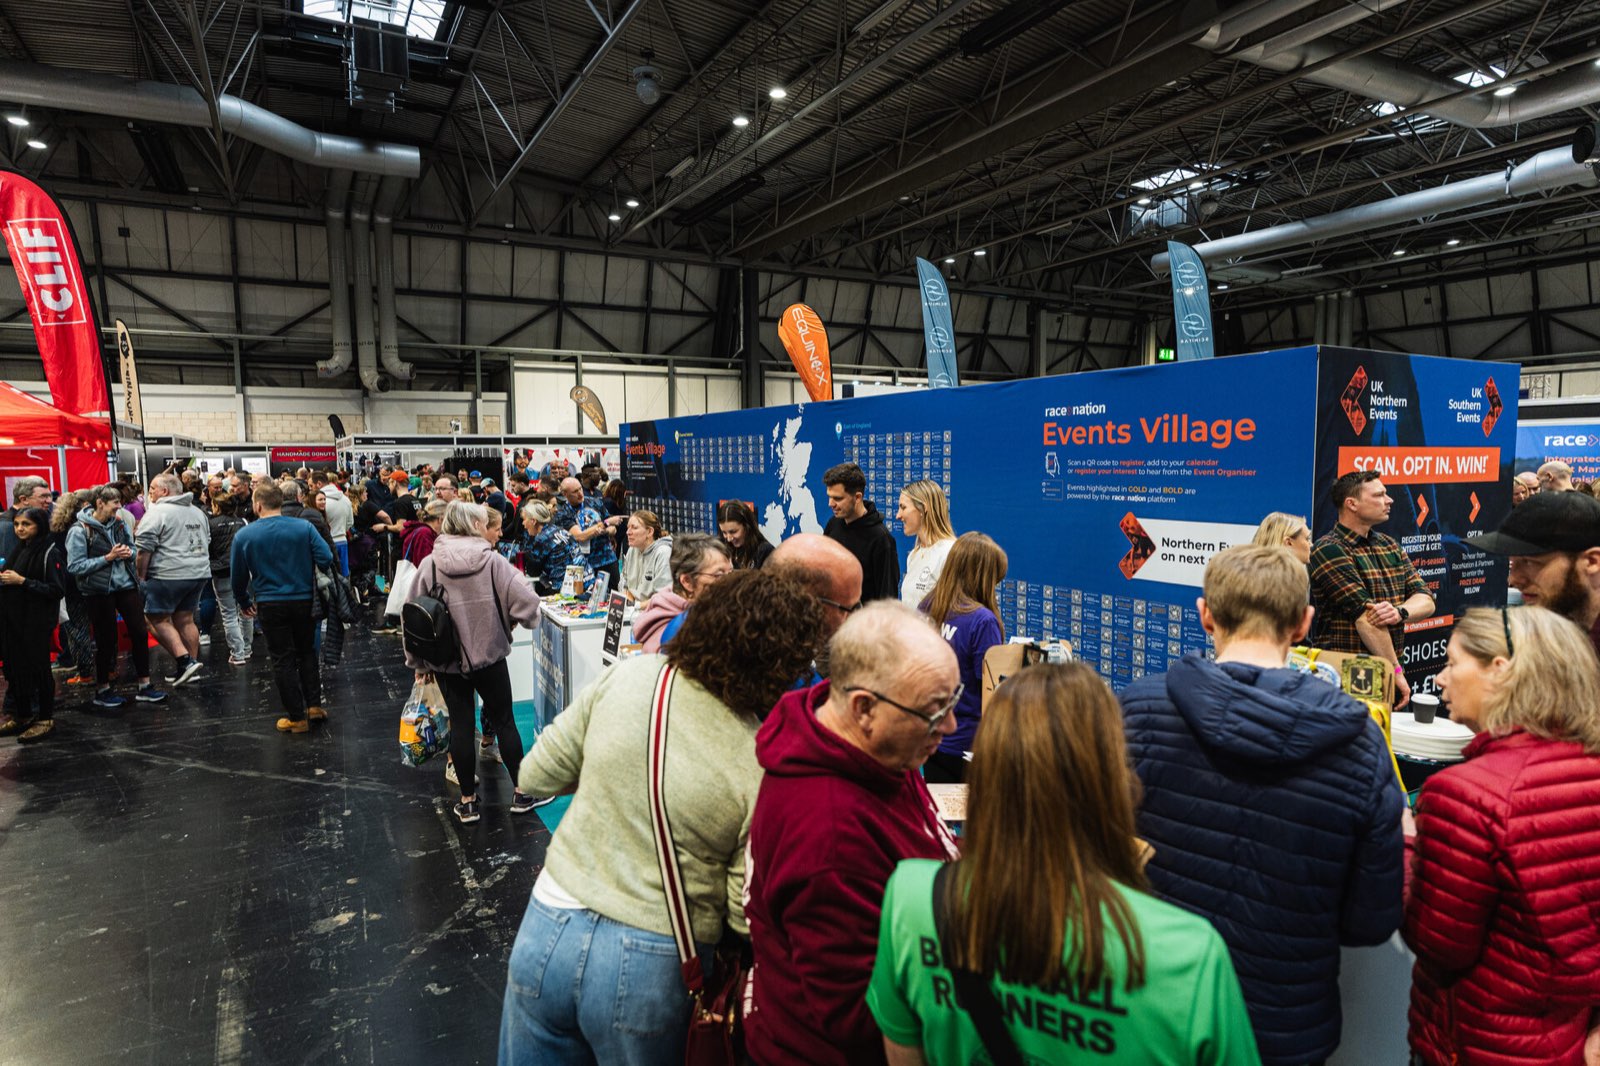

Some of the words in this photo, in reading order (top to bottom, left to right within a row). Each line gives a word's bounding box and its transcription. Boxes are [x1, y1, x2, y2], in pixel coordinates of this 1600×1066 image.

[18, 228, 74, 312] CLIF
[1370, 380, 1384, 393] UK
[1471, 387, 1482, 398] UK
[1370, 395, 1407, 407] Northern
[1448, 399, 1481, 411] Southern
[1369, 408, 1398, 420] Events
[1456, 412, 1481, 423] Events
[1043, 421, 1132, 446] Events
[1139, 413, 1257, 449] Village
[644, 442, 665, 458] Village
[1086, 459, 1096, 467] QR
[1170, 460, 1184, 468] your
[1186, 459, 1219, 467] calendar
[1353, 456, 1399, 475] SCAN.
[1403, 457, 1432, 475] OPT
[1435, 457, 1452, 475] IN.
[1162, 468, 1179, 476] from
[1180, 468, 1193, 476] the
[1217, 468, 1257, 477] Organiser
[1163, 486, 1184, 494] BOLD
[1092, 494, 1099, 502] by
[1161, 537, 1215, 551] Northern
[1401, 534, 1427, 544] REGISTER
[1427, 533, 1442, 541] YOUR
[1402, 543, 1426, 553] NTEREST
[1161, 552, 1176, 561] on
[1178, 553, 1205, 565] next
[1420, 557, 1446, 566] in-season
[1464, 586, 1480, 595] BELOW
[1403, 639, 1447, 664] SHOES
[933, 976, 1117, 1056] RNERS
